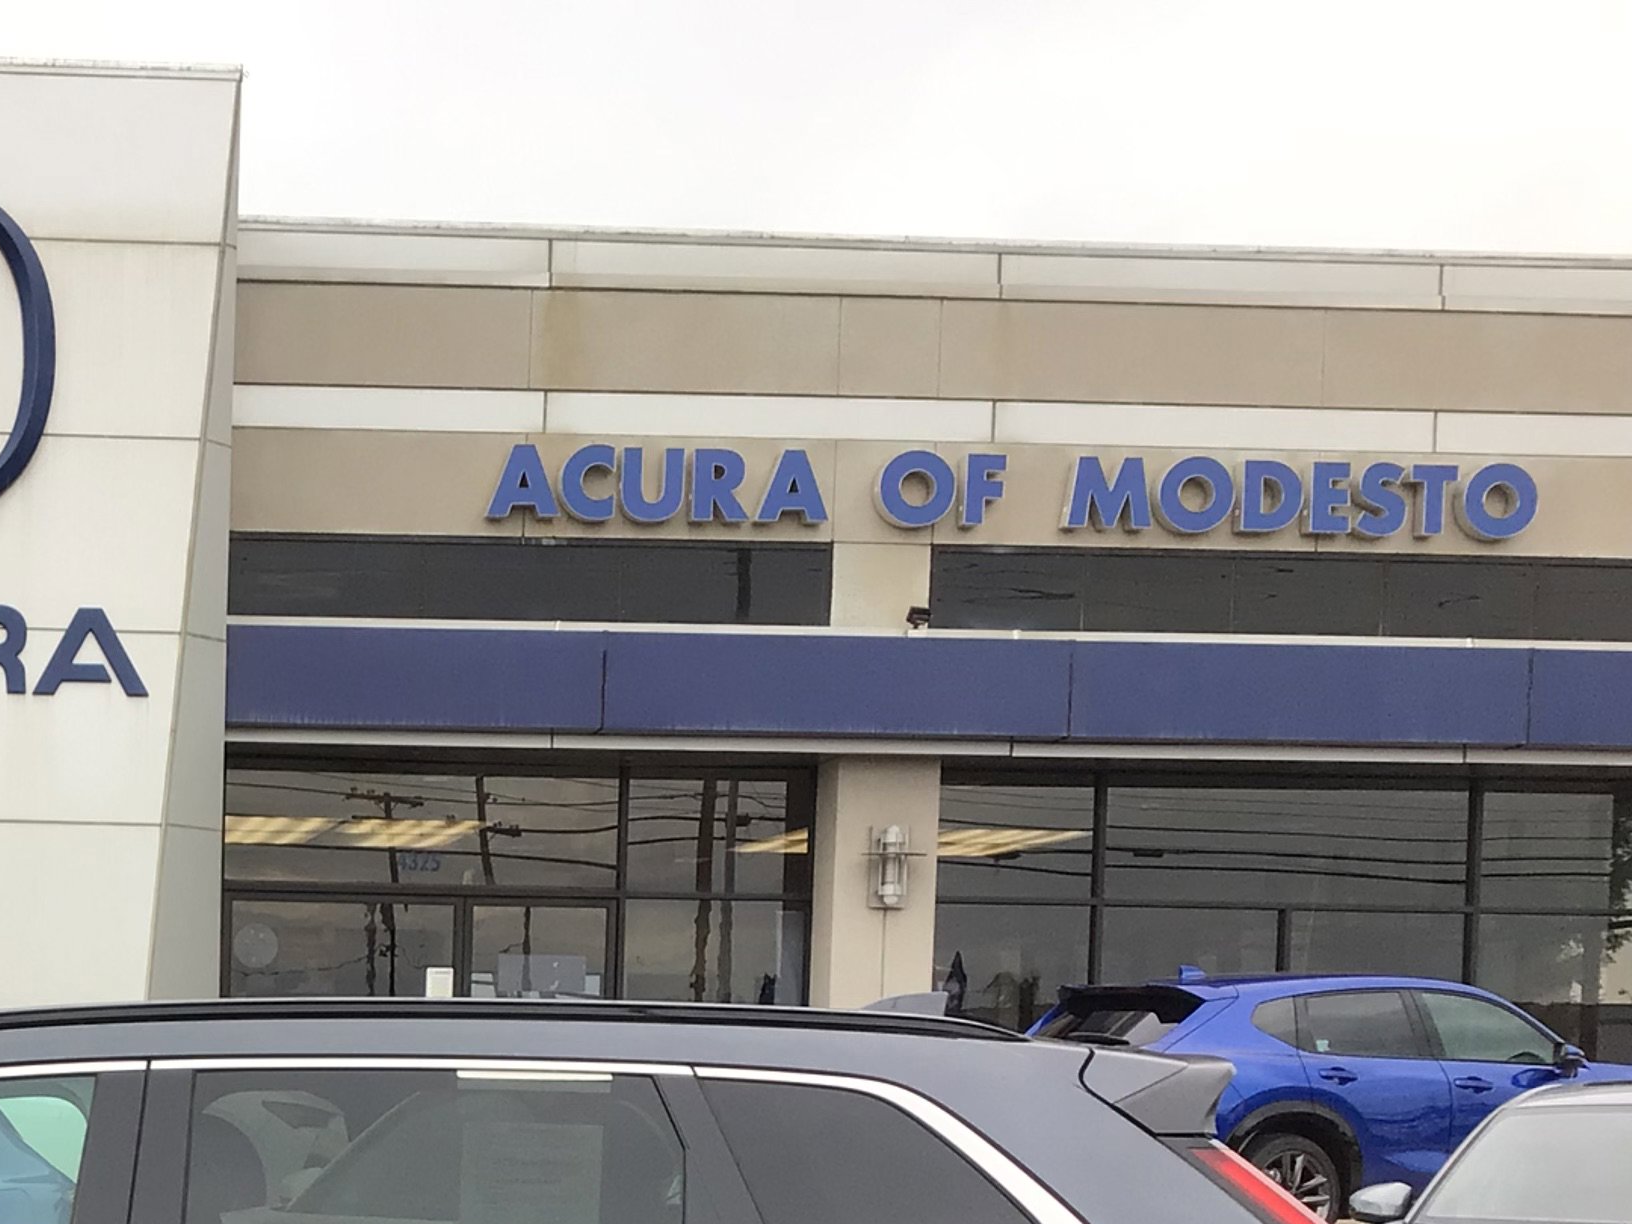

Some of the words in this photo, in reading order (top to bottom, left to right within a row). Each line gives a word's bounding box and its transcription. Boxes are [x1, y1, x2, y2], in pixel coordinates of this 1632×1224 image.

[485, 440, 829, 524] ACURA
[874, 449, 1009, 528] OF
[1062, 454, 1540, 544] MODESTO
